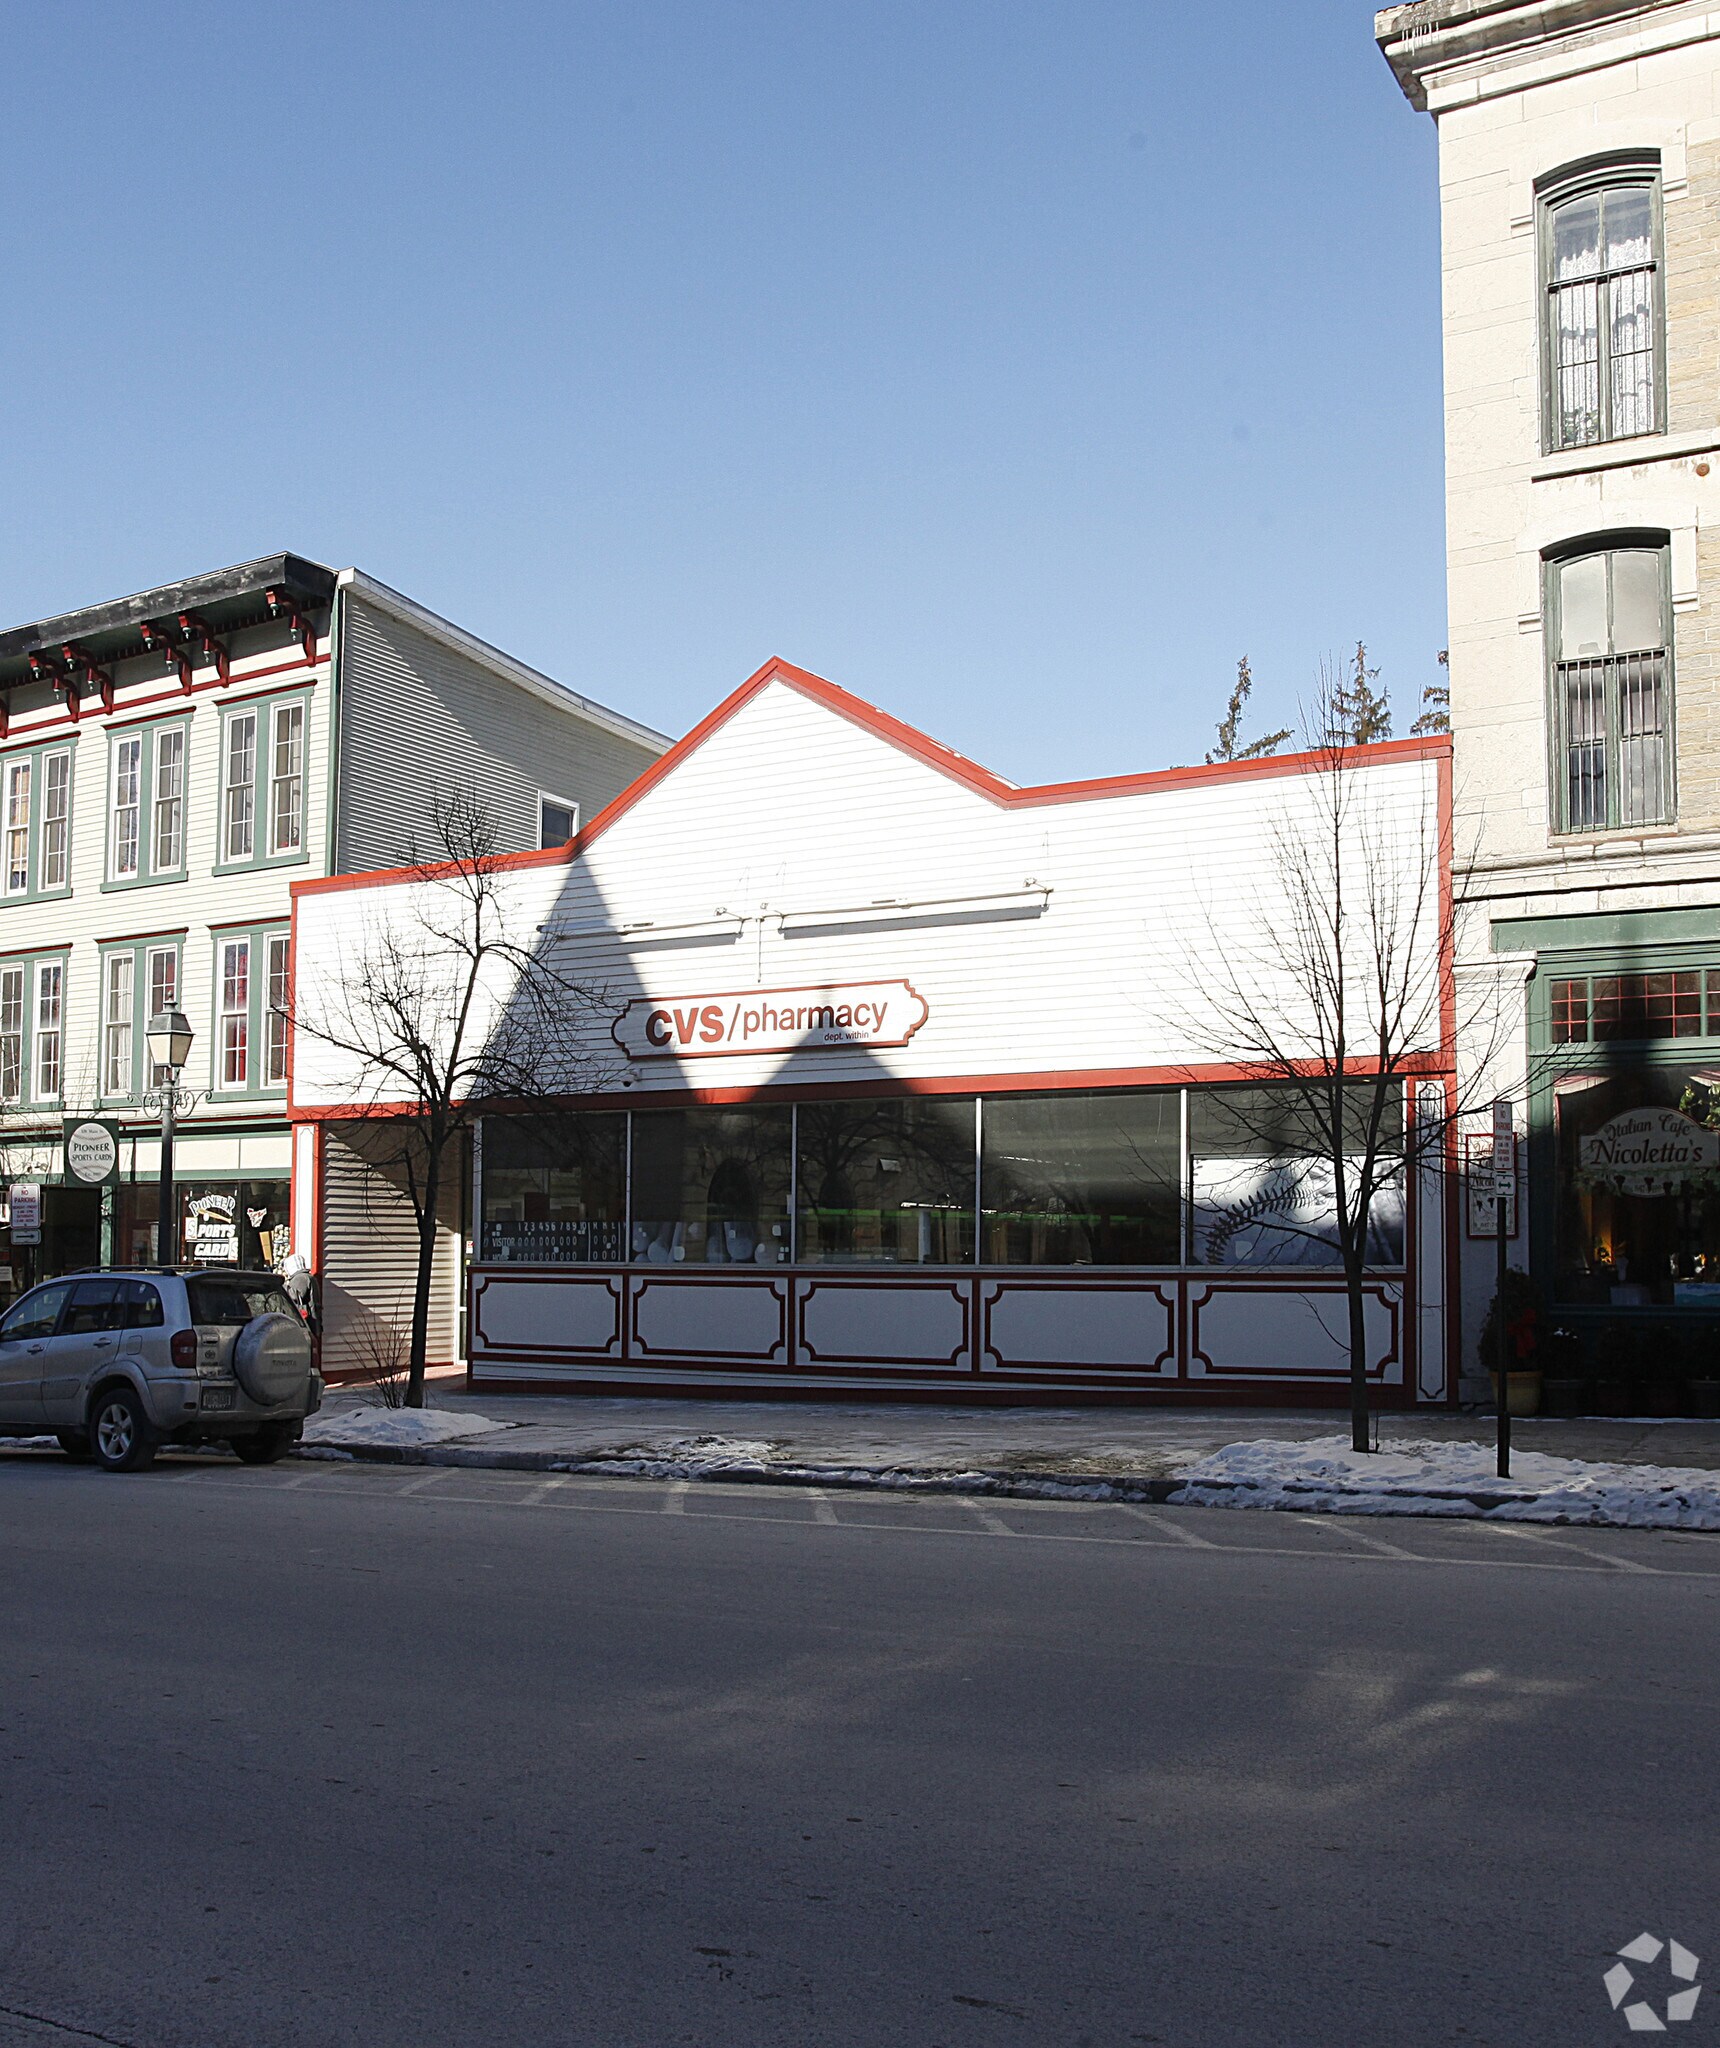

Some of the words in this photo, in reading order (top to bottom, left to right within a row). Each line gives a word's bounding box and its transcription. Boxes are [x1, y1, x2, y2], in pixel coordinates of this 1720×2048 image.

[645, 1002, 888, 1047] CVS/pharmacy
[824, 1032, 843, 1041] dept.
[846, 1030, 870, 1040] within
[1607, 1118, 1652, 1141] Italian
[73, 1143, 110, 1152] PIONEER
[1589, 1138, 1703, 1165] Nicoletta's
[188, 1194, 236, 1217] PIONEER
[186, 1219, 236, 1239] SPORTS
[194, 1239, 238, 1258] CARDS
[492, 1237, 515, 1247] VISITOR
